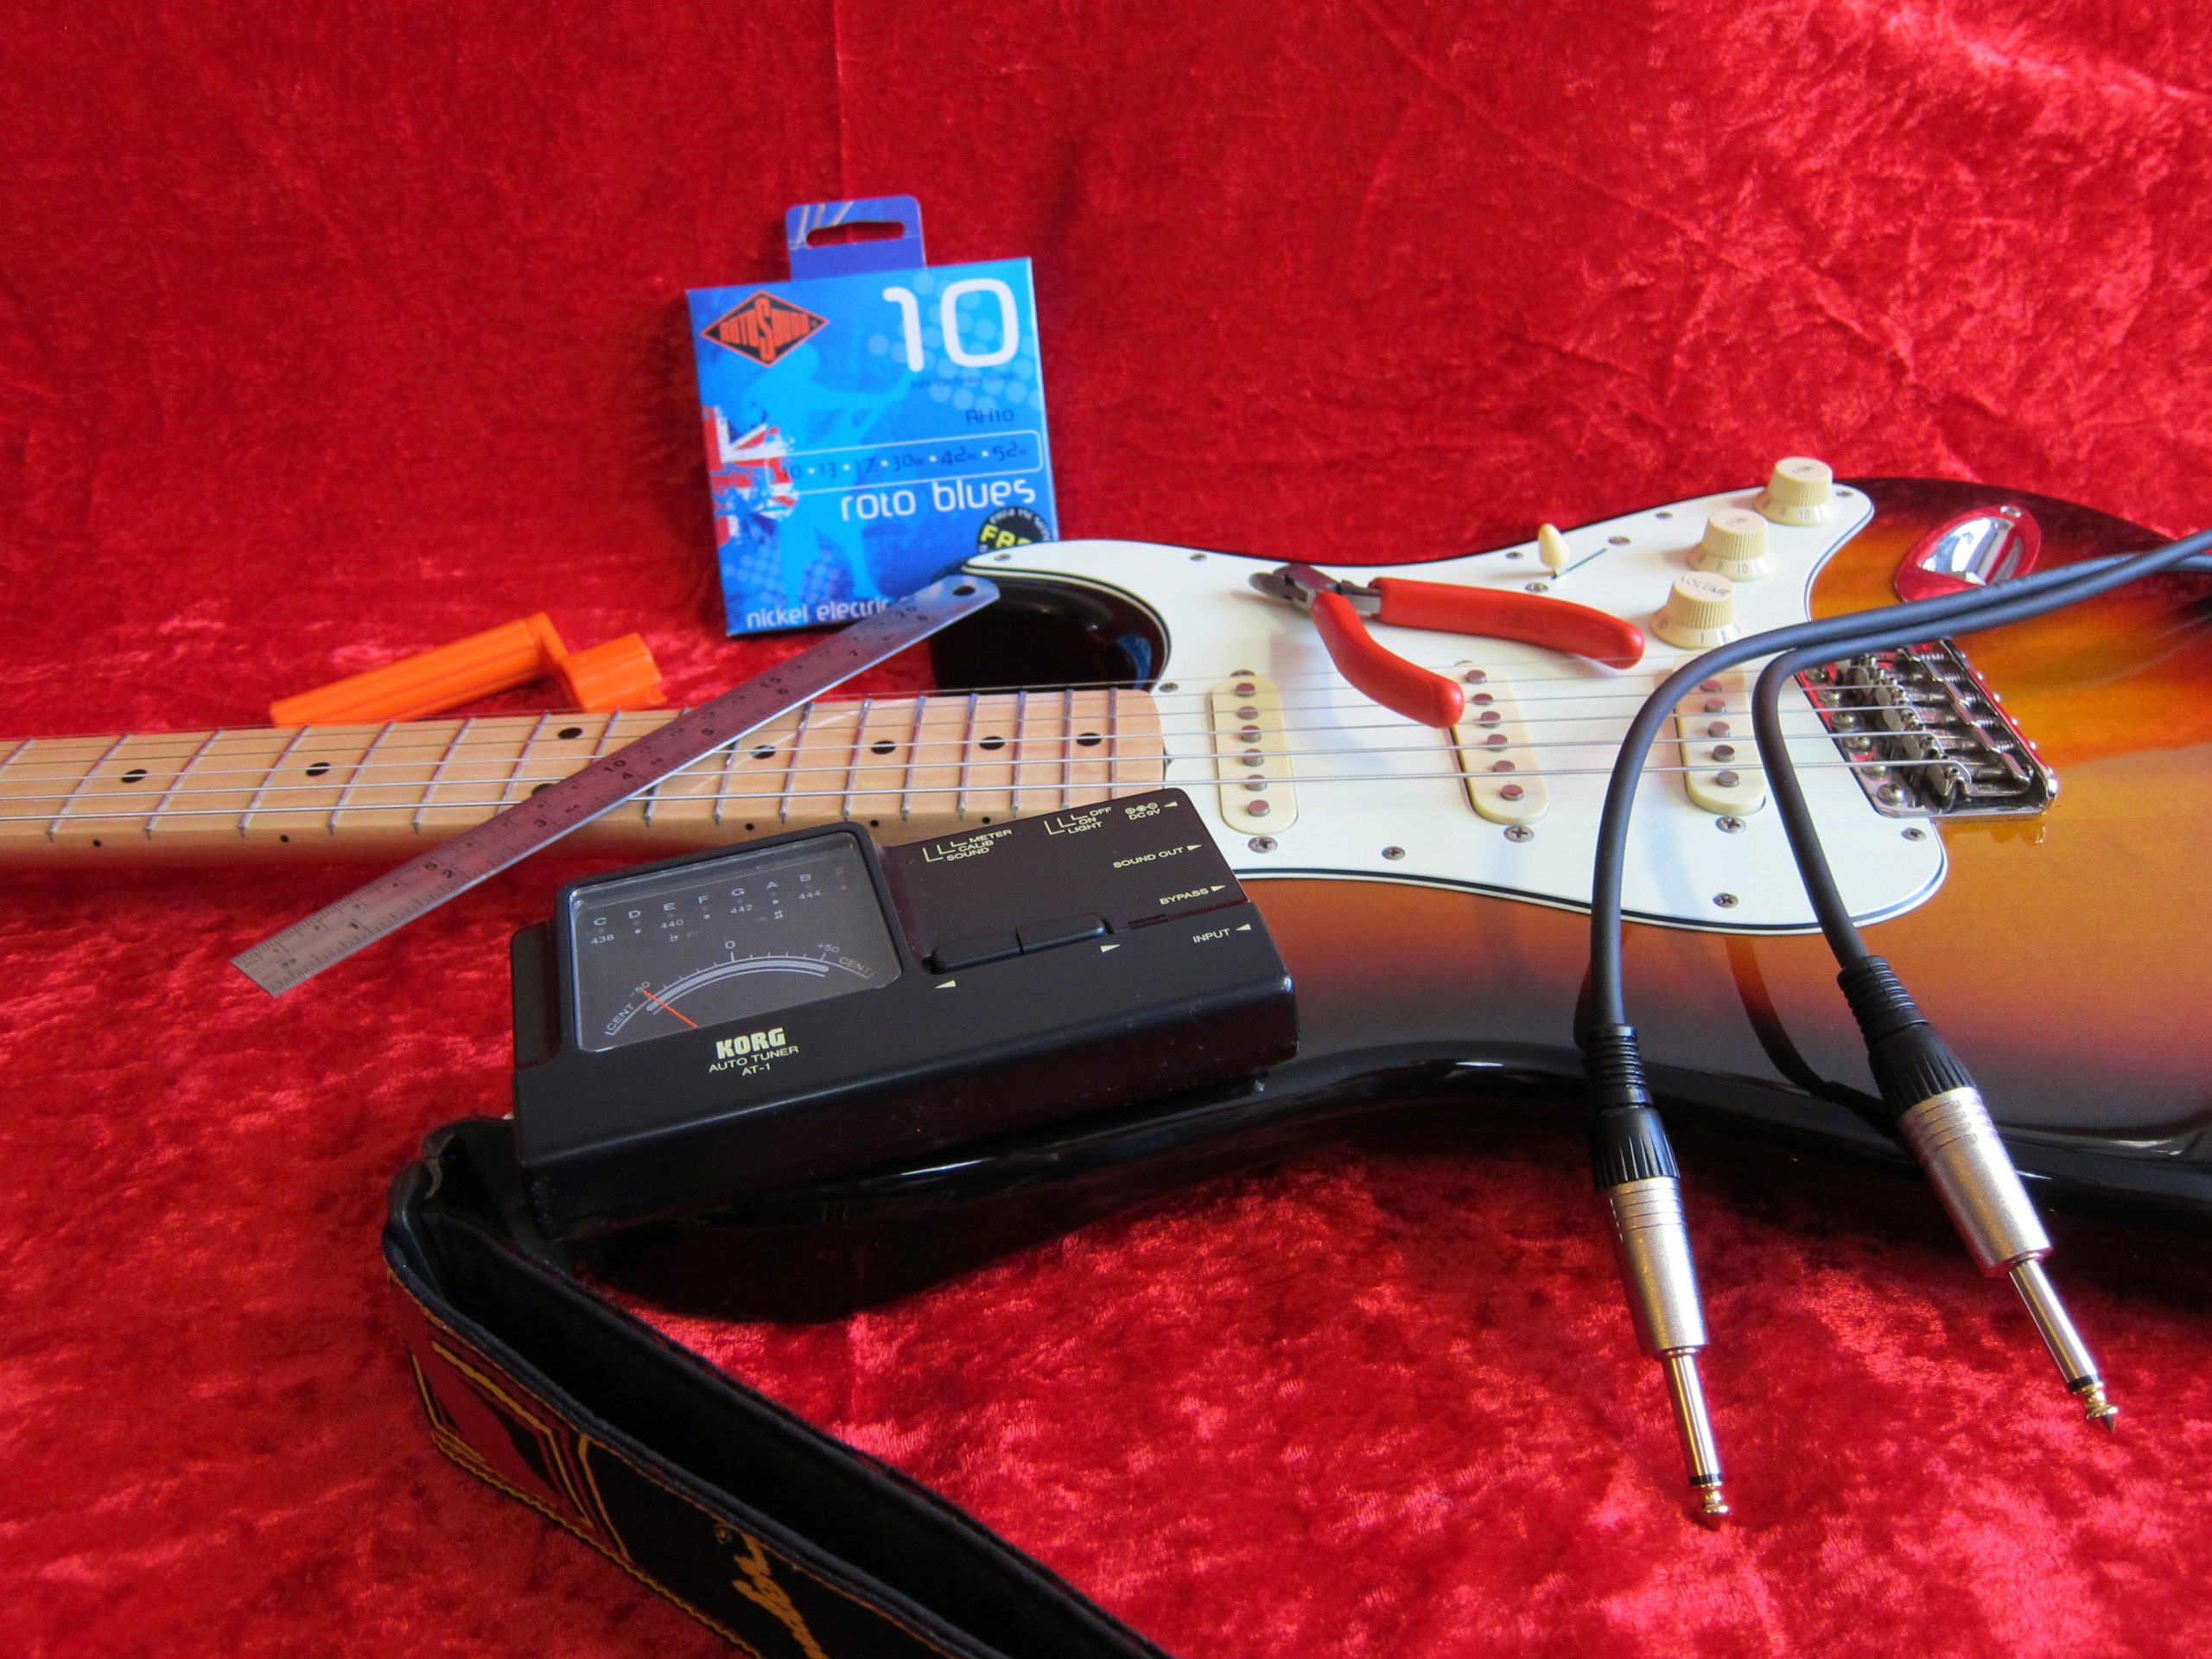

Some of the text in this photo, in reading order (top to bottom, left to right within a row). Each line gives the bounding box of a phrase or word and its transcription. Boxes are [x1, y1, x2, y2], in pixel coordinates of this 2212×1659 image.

[882, 278, 1020, 372] 10
[820, 461, 839, 479] 13
[855, 458, 875, 474] 17
[841, 479, 1037, 522] roto blues
[1800, 509, 1810, 519] 10
[1737, 563, 1748, 574] 10
[747, 604, 808, 629] nickel
[603, 760, 626, 772] 10
[442, 869, 453, 879] 2
[533, 819, 547, 828] 3
[622, 772, 633, 780] 4
[702, 728, 715, 736] 5
[1089, 806, 1112, 817] OFF
[1067, 821, 1103, 835] LIGHT
[1078, 817, 1097, 825] ON
[969, 829, 1013, 844] METER
[946, 847, 990, 861] SOUND
[957, 839, 995, 853] CALIB
[1113, 847, 1184, 868] SOUND OUT
[594, 917, 607, 926] C
[628, 910, 641, 918] D
[664, 902, 677, 912] E
[698, 895, 709, 904] F
[731, 888, 745, 897] G
[799, 874, 812, 882] B
[1159, 887, 1209, 905] BYPASS
[591, 890, 821, 944] 438 440 442 444
[1192, 928, 1230, 944] INPUT
[607, 1002, 634, 1032] CENT
[725, 940, 736, 950] 0
[817, 943, 841, 954] +50
[838, 957, 871, 975] CENT
[715, 1027, 787, 1060] KORG
[709, 1046, 799, 1072] AUTO TUNER
[741, 1063, 771, 1077] AT-1
